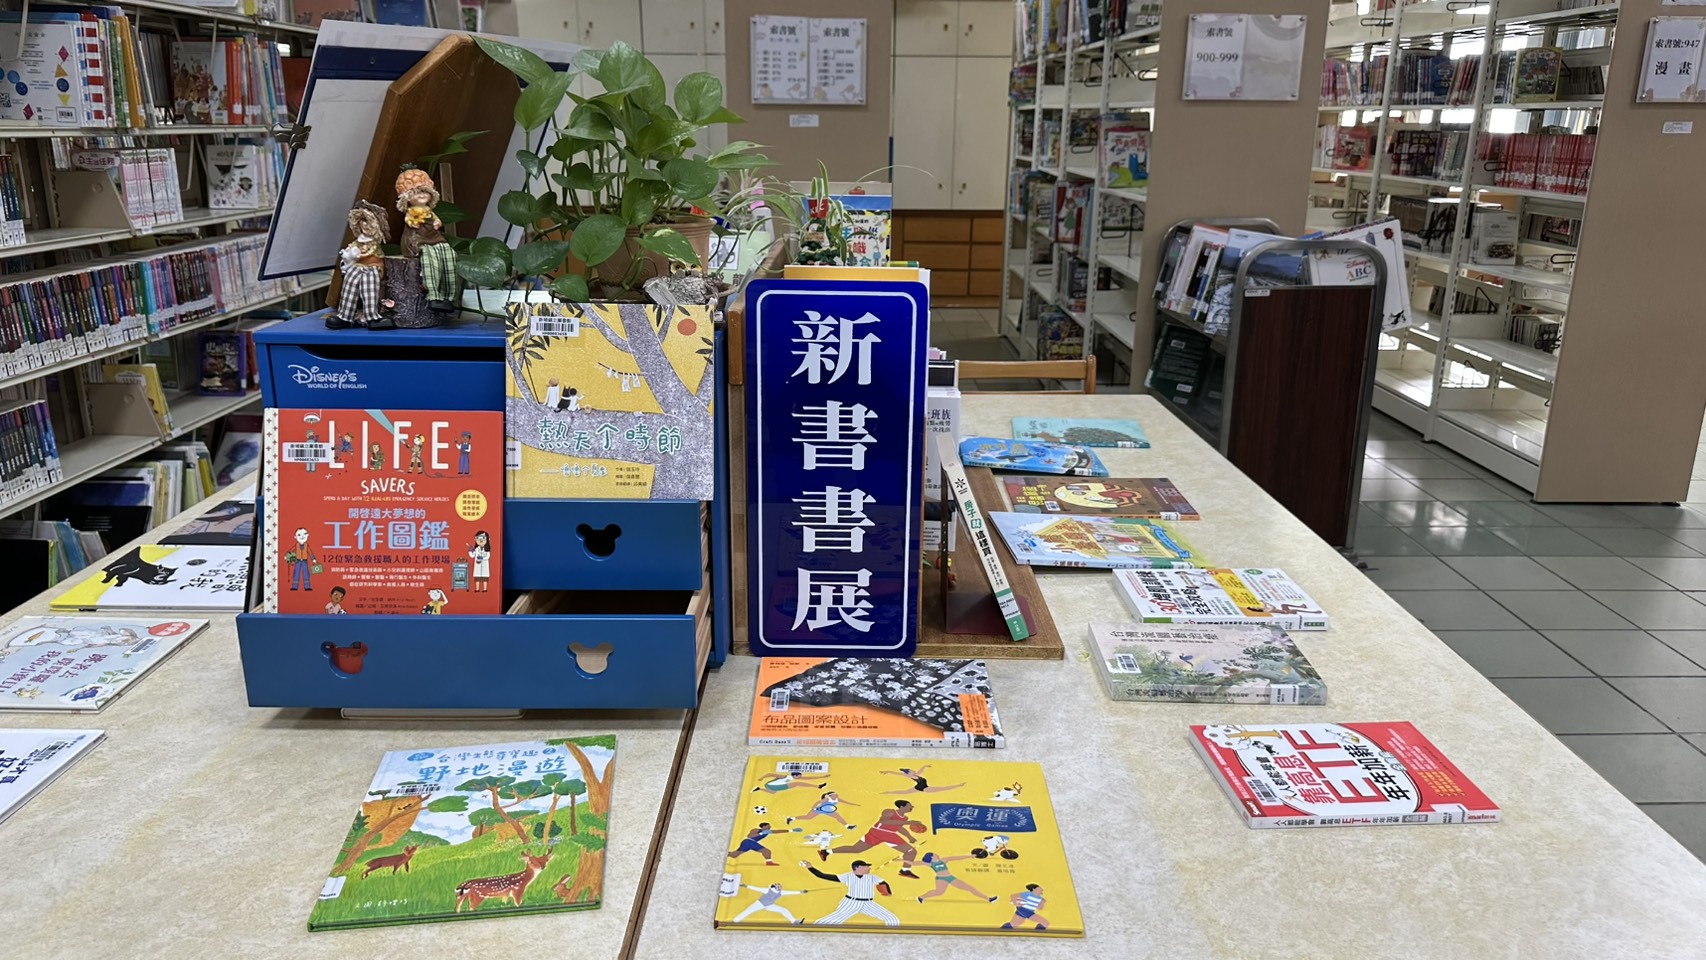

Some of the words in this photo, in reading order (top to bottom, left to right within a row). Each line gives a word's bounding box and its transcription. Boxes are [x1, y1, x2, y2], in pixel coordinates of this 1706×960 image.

[769, 25, 797, 36] 索書號
[823, 27, 850, 37] 索書號
[1206, 27, 1233, 38] 索書號
[1655, 39, 1701, 49] 索書號:947
[1196, 52, 1239, 62] 900-999
[288, 364, 358, 389] Disney's
[928, 409, 952, 420] 班族
[328, 419, 450, 470] LIFE
[790, 310, 882, 632] 新書書展
[361, 477, 415, 495] SAVERS
[322, 520, 450, 551] 工作圖鑑
[763, 714, 868, 725] 布品圖案設計
[418, 755, 567, 783] 野地漫遊
[1280, 730, 1390, 804] ETF
[1343, 744, 1411, 801] 年年加薪
[1272, 754, 1336, 804] 靠高息
[955, 807, 1010, 822] 奧運
